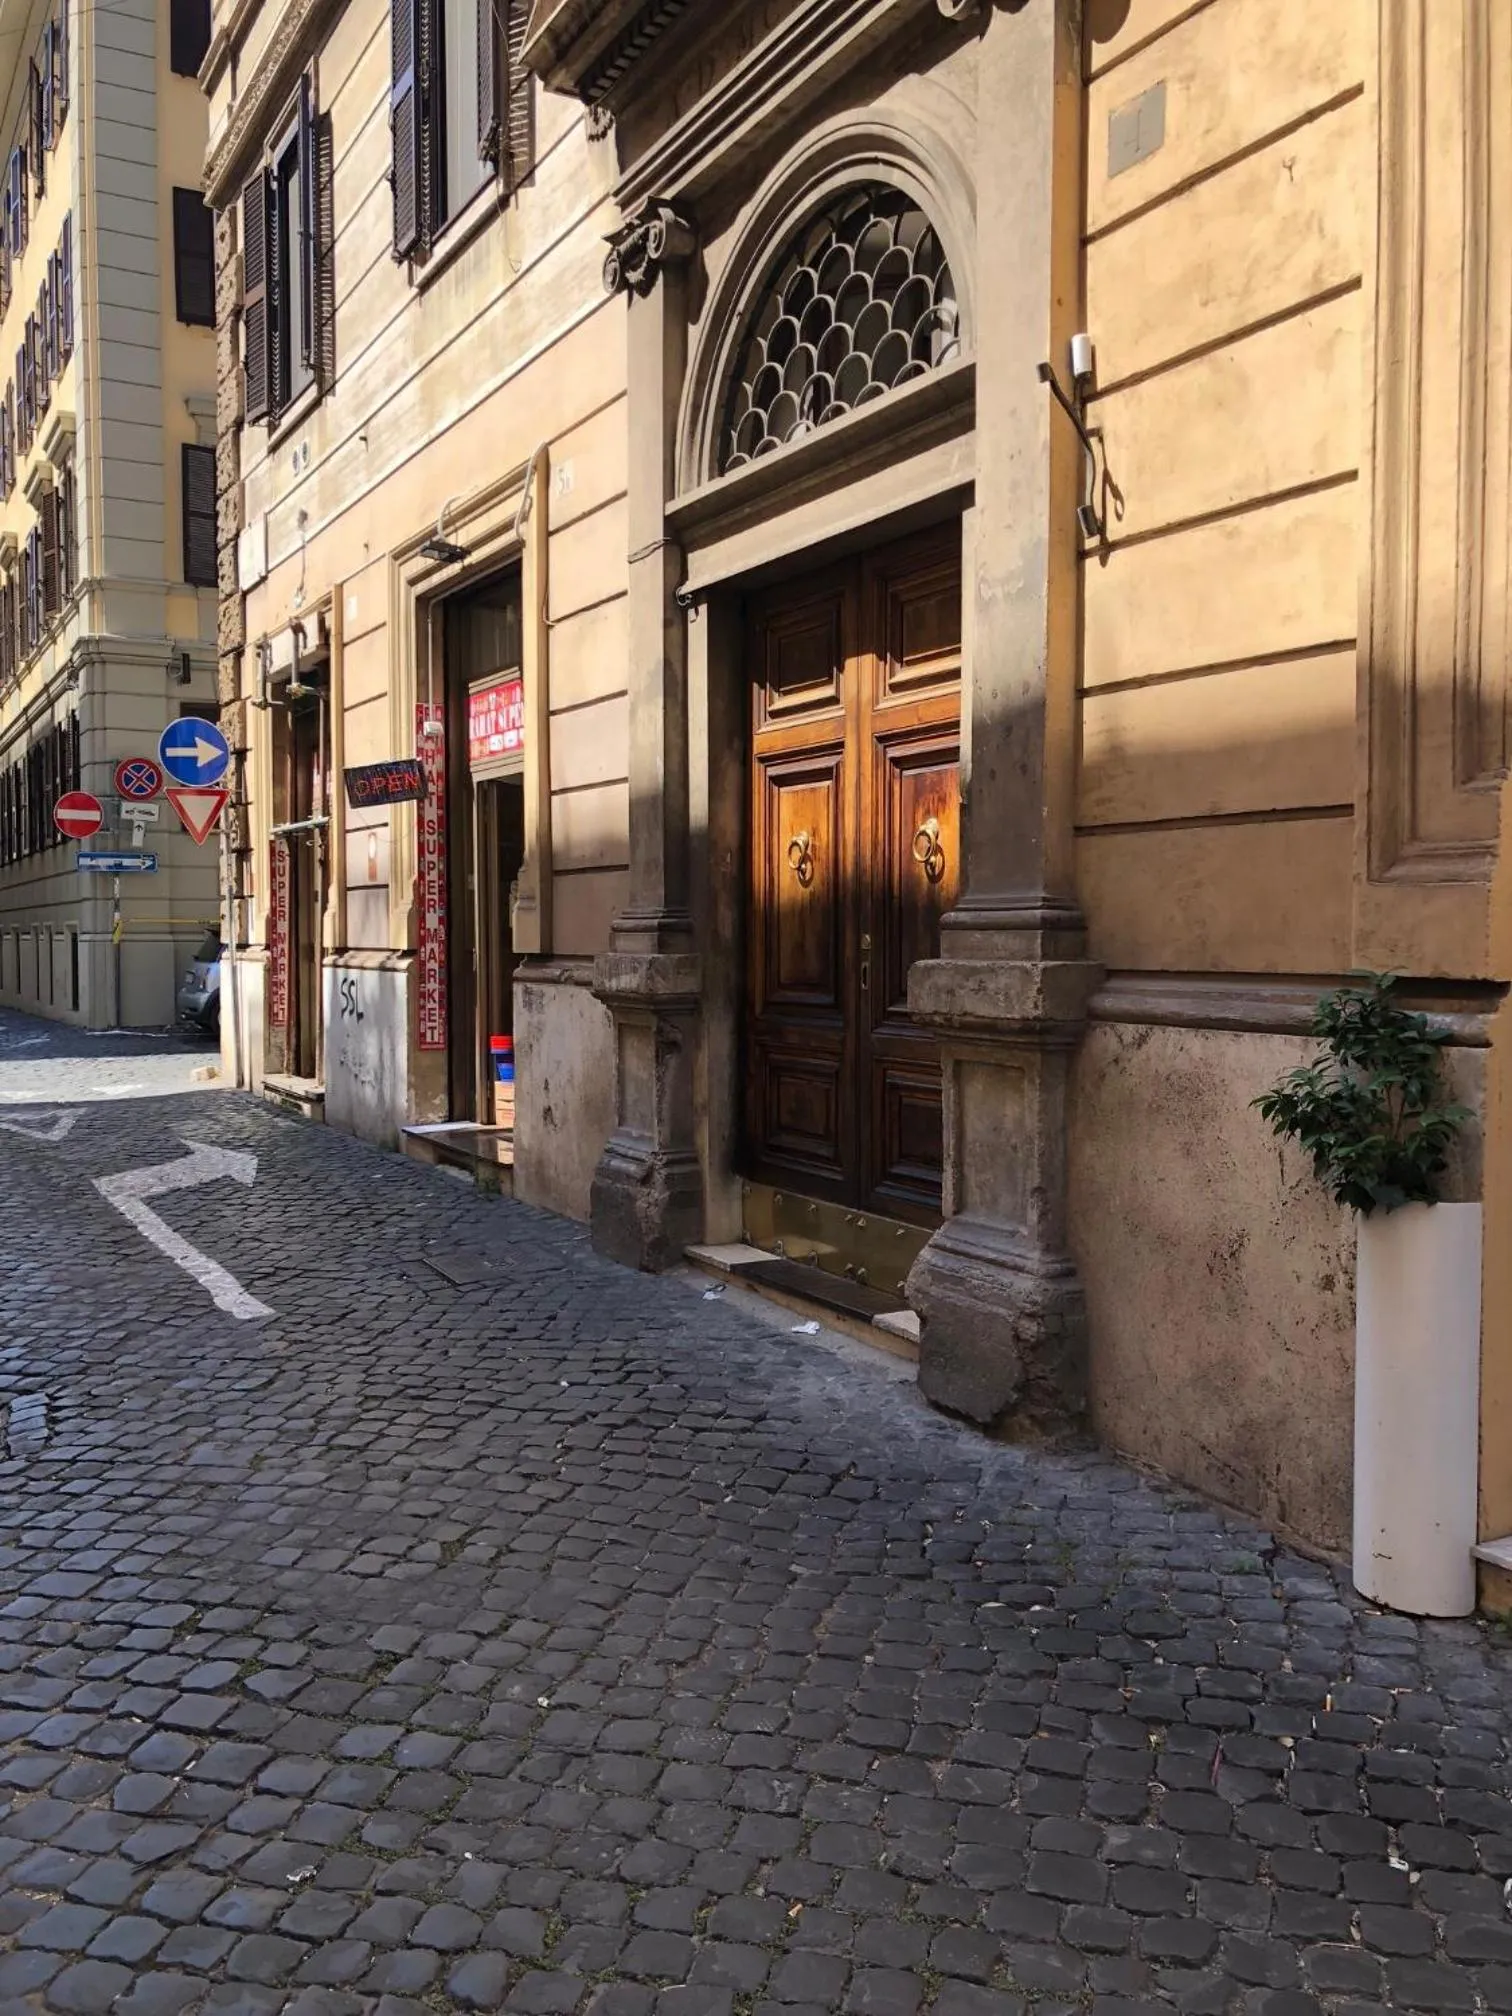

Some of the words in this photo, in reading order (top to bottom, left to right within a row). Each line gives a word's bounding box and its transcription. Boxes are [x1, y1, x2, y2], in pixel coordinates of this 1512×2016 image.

[355, 770, 418, 797] OPEN
[277, 850, 286, 922] SUPER
[426, 819, 437, 914] SUPER
[277, 931, 287, 1020] MARKET
[427, 927, 438, 1042] MARKET
